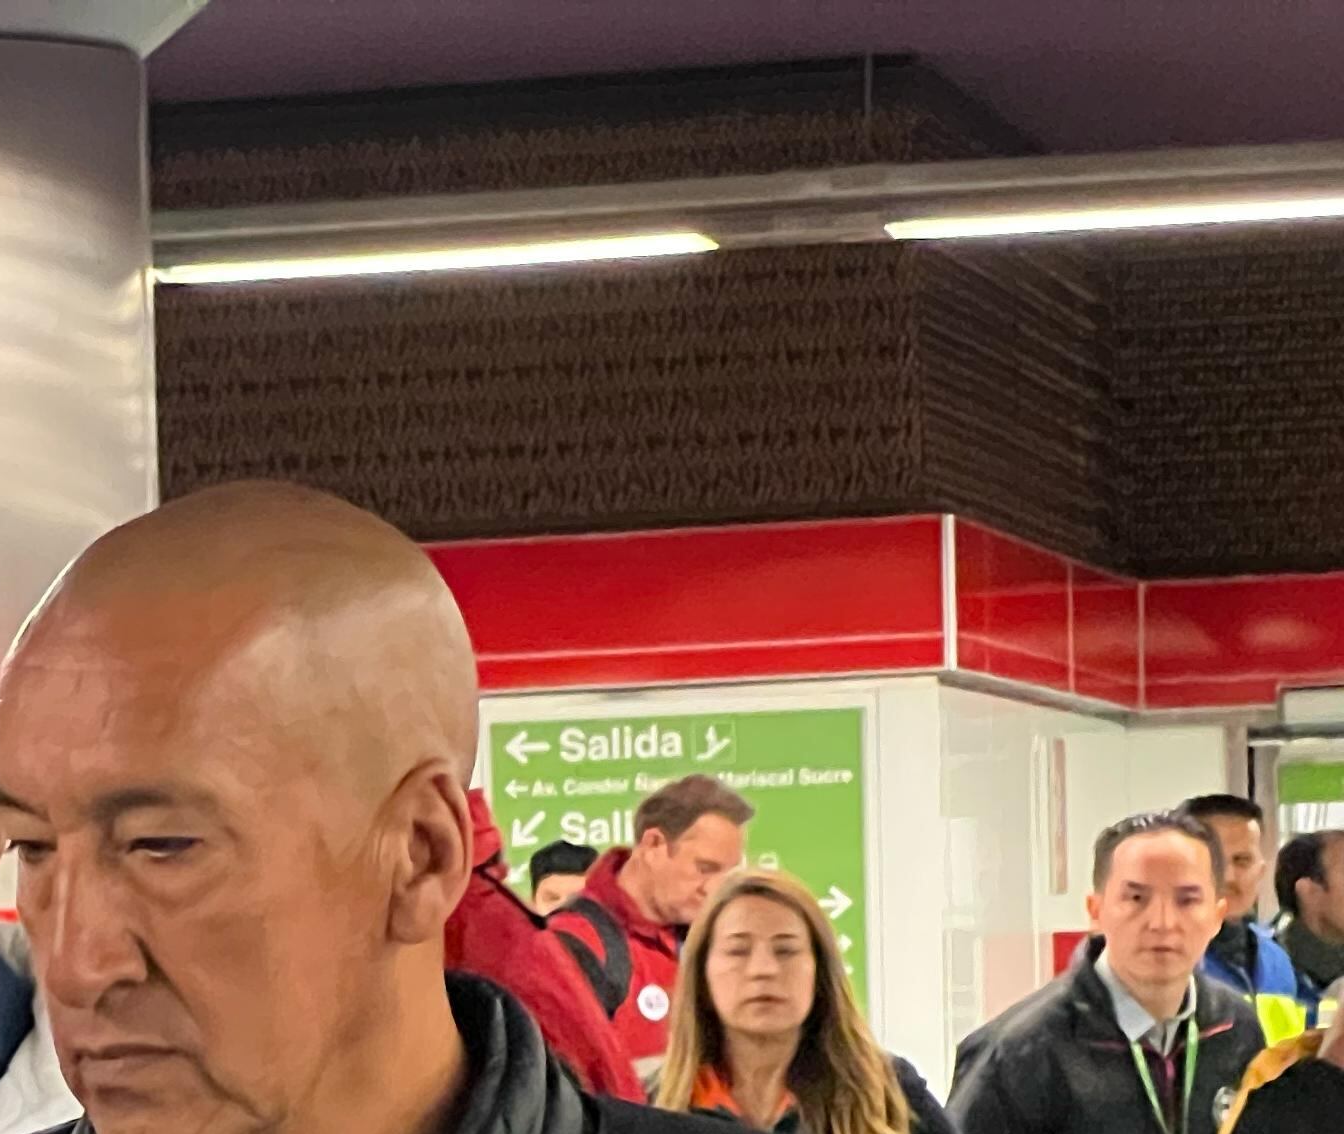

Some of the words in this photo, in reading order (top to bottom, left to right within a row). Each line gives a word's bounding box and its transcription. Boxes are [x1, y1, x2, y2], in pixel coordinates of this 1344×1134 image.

[559, 724, 683, 762] Salida
[799, 767, 853, 786] Sucre
[560, 810, 634, 846] Sali
